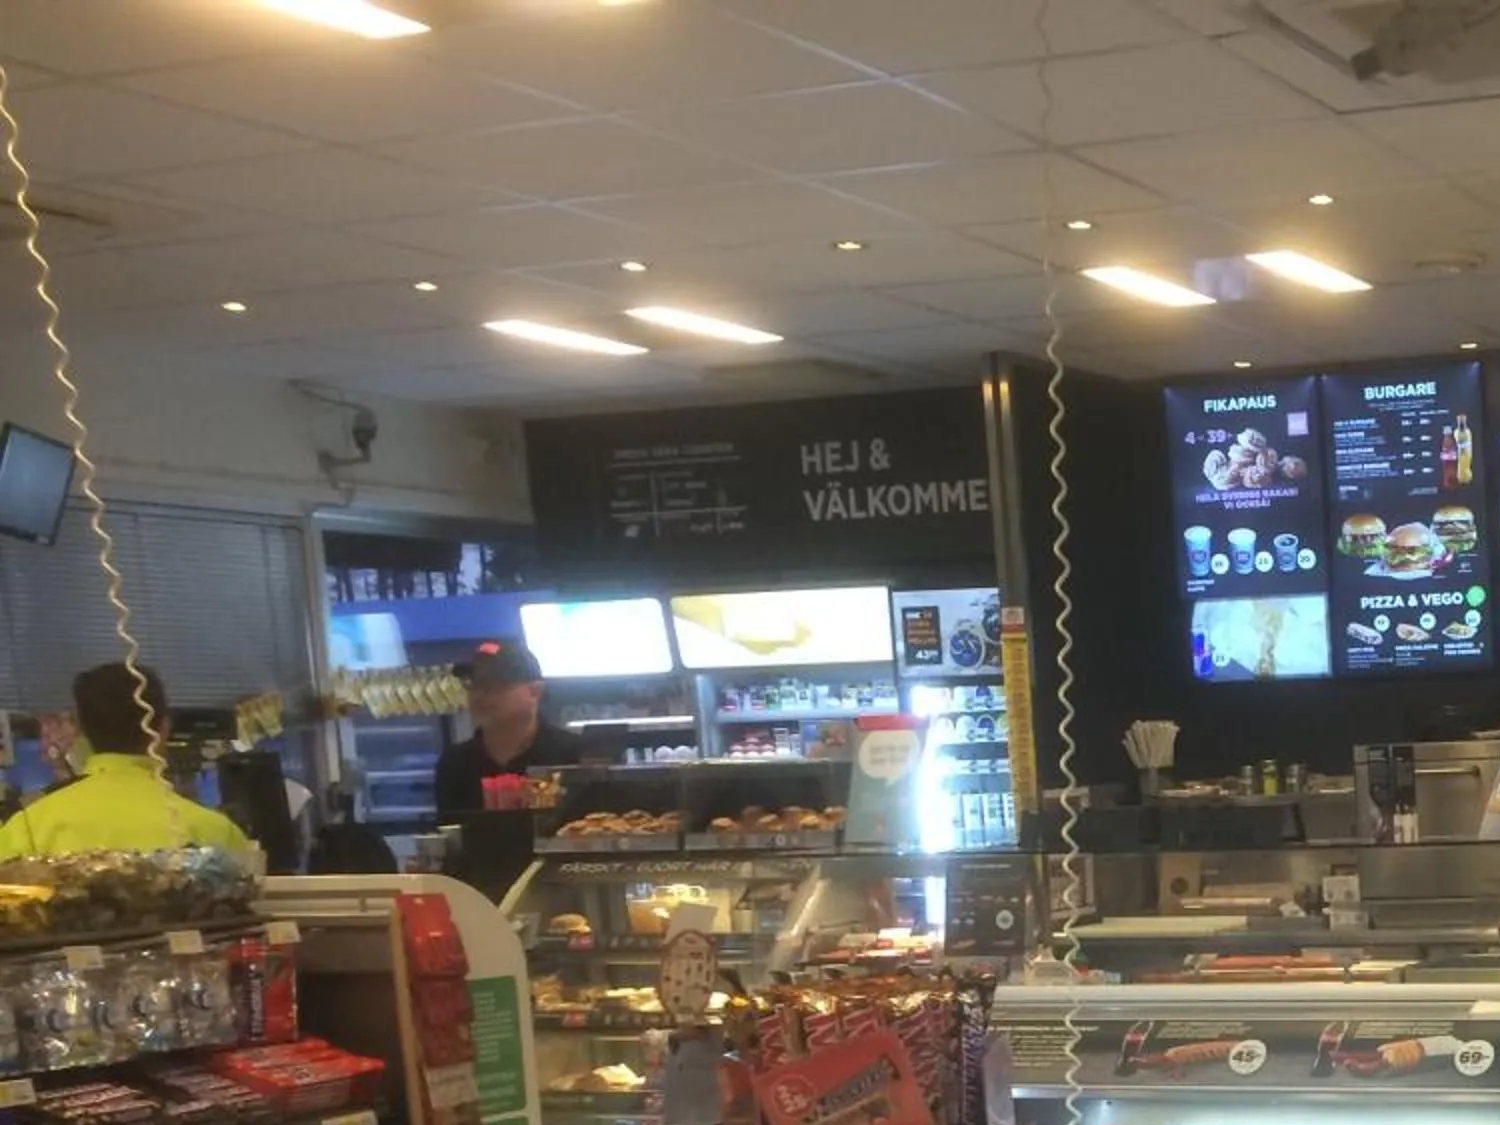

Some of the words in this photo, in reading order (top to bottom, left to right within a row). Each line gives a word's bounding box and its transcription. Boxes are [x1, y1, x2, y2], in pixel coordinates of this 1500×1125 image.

[1364, 382, 1437, 400] BURGARE
[1203, 395, 1277, 413] FIKAPAUS
[801, 440, 859, 475] HEJ
[869, 438, 891, 470] &
[1360, 595, 1404, 609] PIZZA
[1407, 594, 1418, 607] &
[1421, 592, 1464, 606] VEGO
